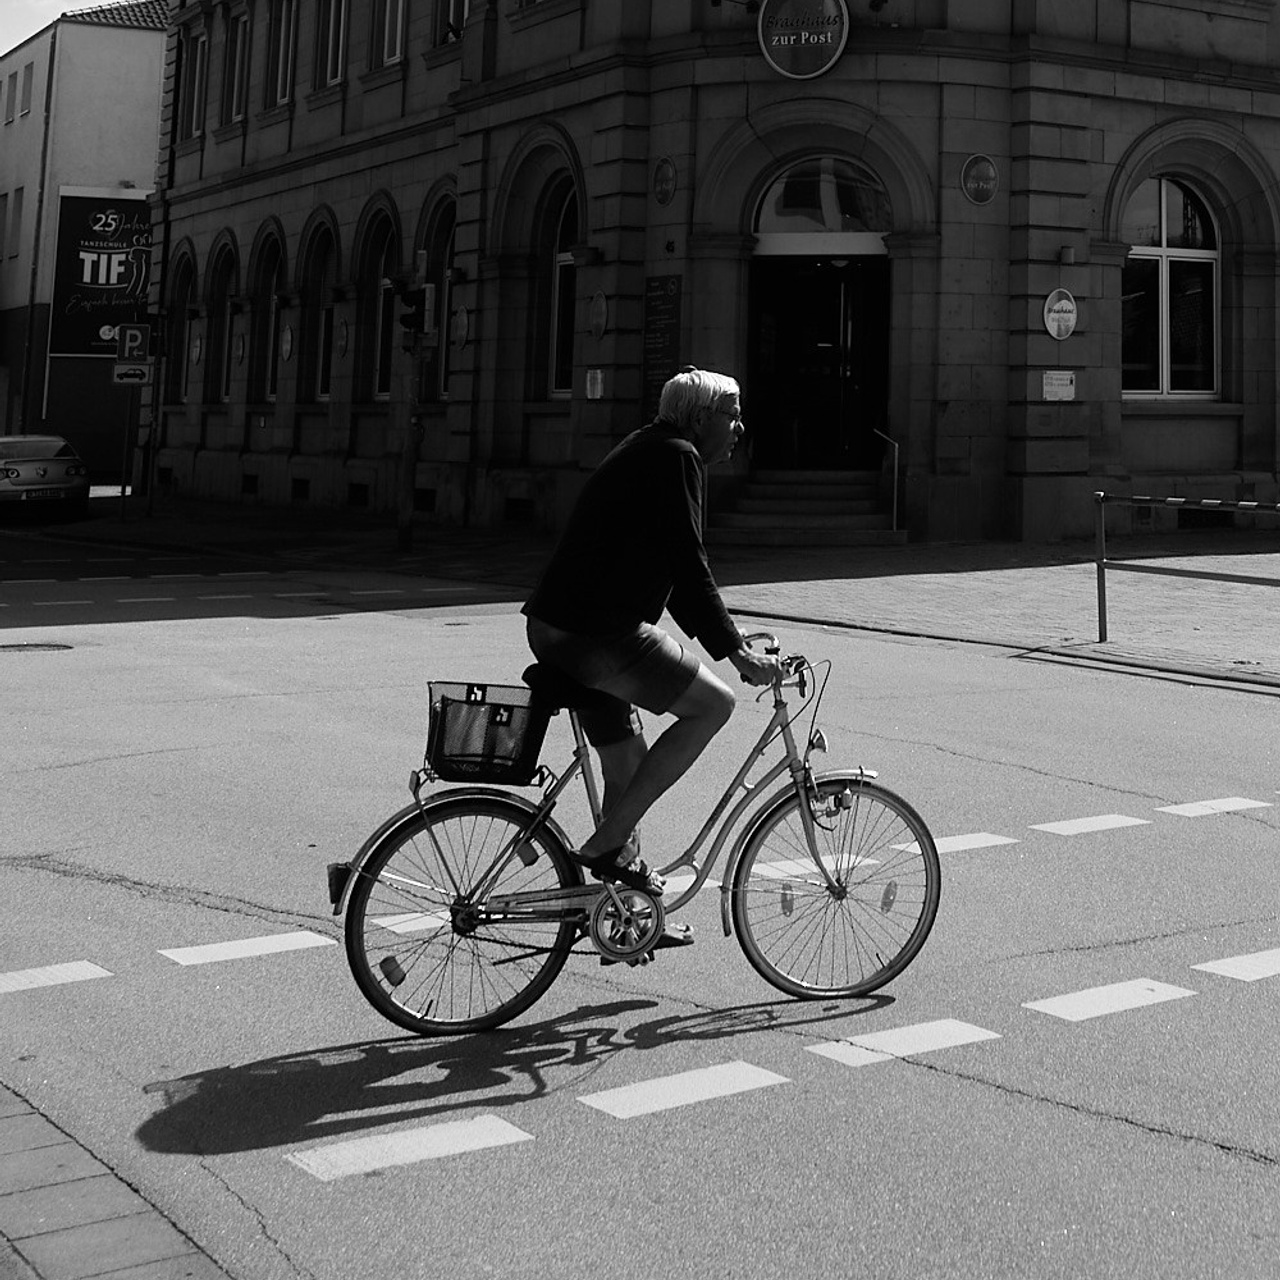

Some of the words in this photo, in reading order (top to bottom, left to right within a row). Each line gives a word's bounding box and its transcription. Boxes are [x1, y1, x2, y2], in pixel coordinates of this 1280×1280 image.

[766, 8, 840, 29] Brauhaus
[771, 35, 796, 46] zur
[801, 31, 832, 45] Post
[92, 213, 118, 231] 25
[80, 239, 127, 249] TANZSCHULE
[79, 250, 127, 285] TIF
[124, 329, 143, 358] P
